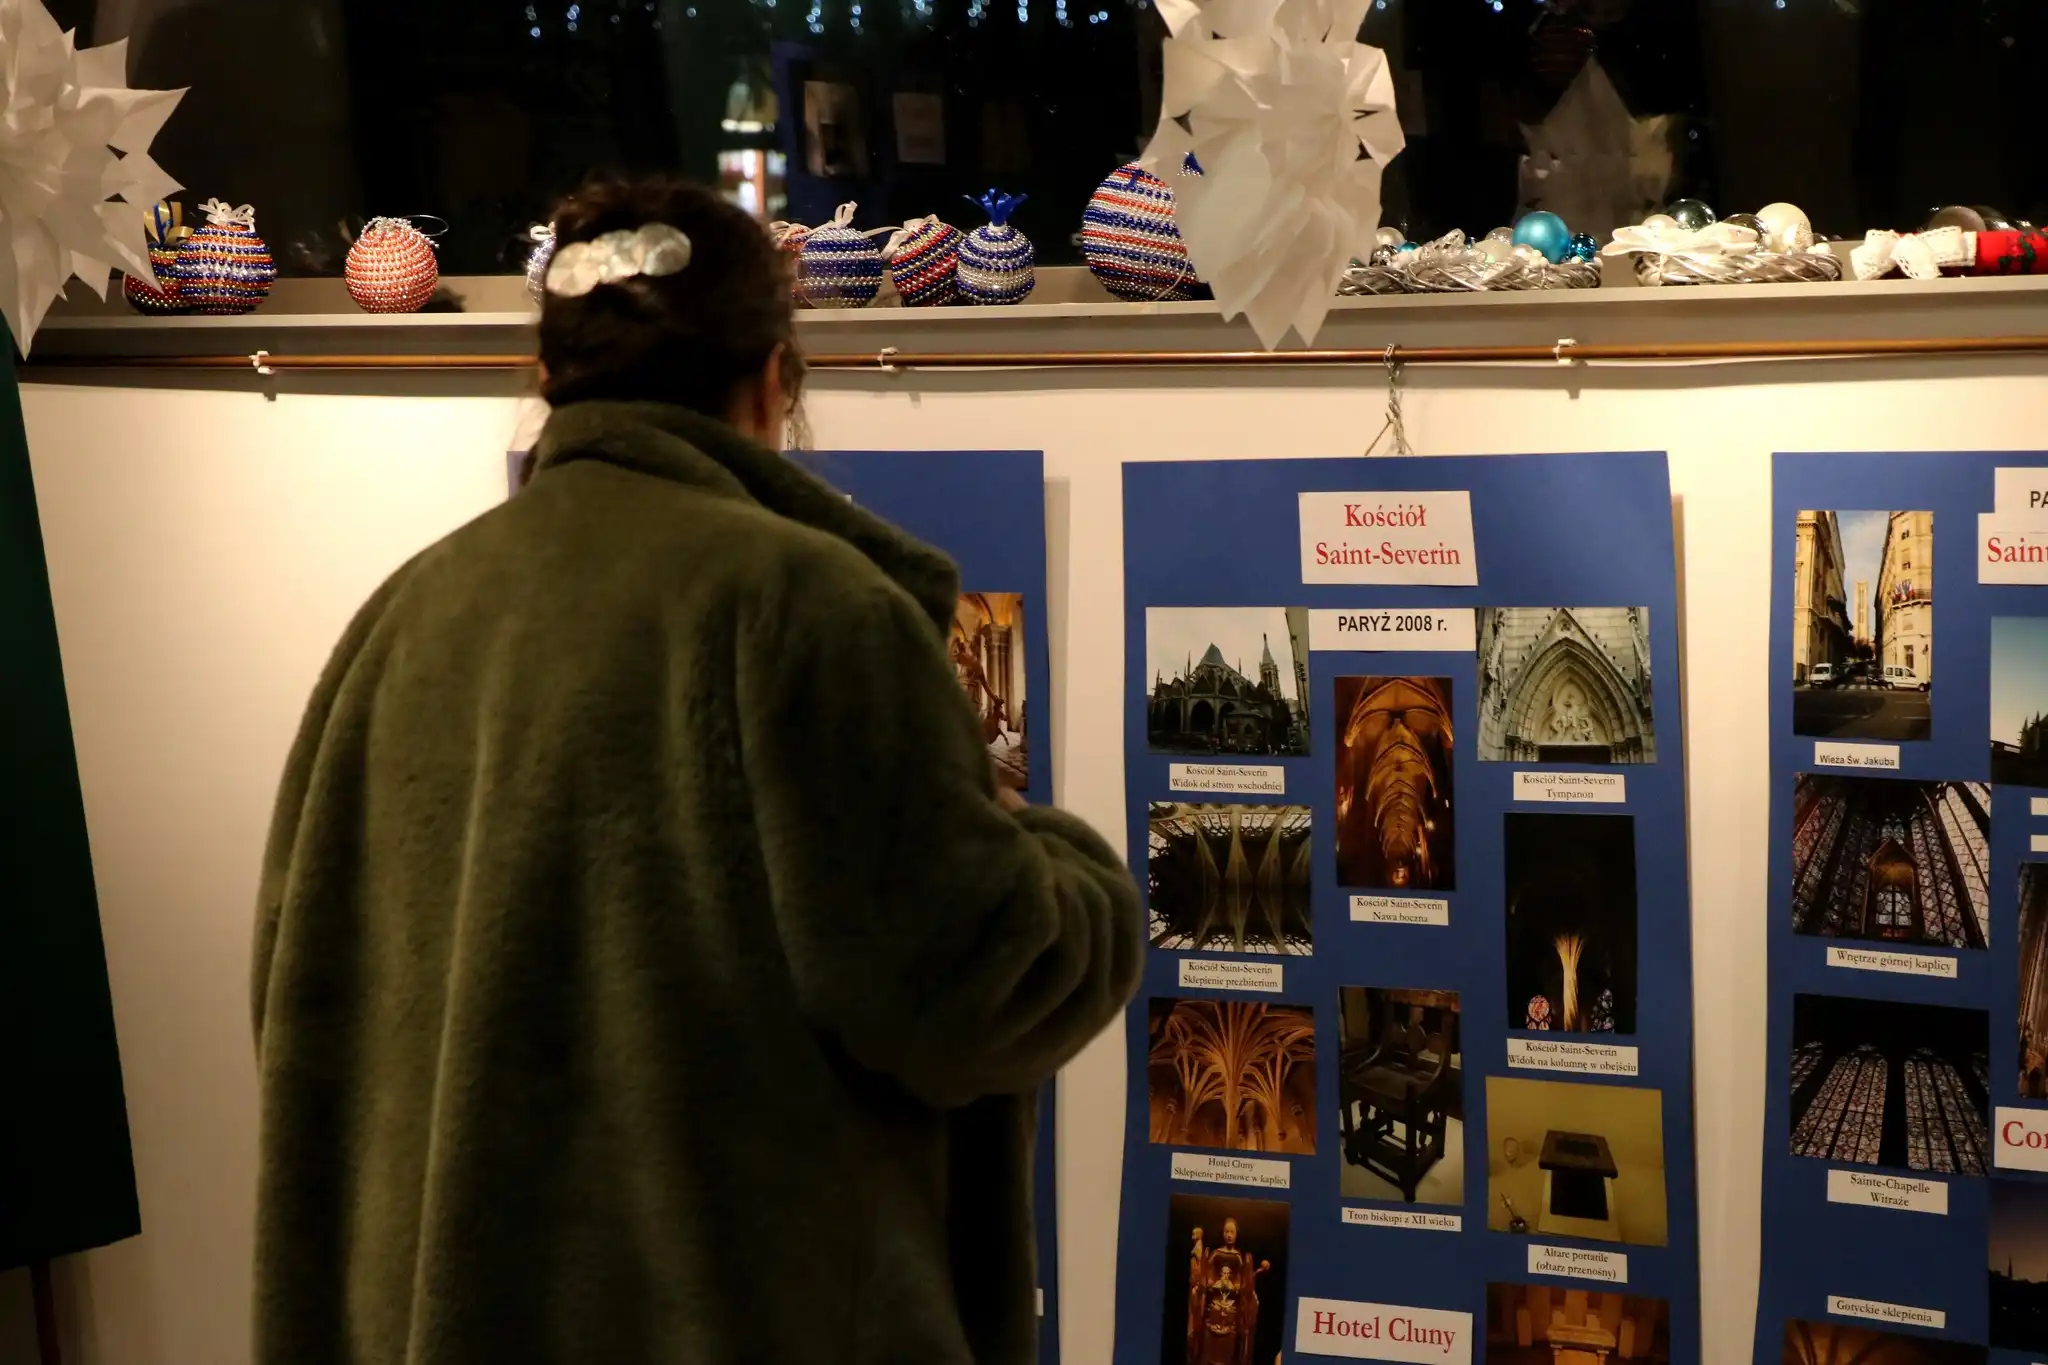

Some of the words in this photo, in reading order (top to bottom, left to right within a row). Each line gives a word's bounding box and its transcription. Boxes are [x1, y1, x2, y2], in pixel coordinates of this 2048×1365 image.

[1344, 504, 1427, 527] Kościół
[1316, 541, 1461, 565] Saint-Severin
[1338, 612, 1391, 631] PARYŻ
[1395, 615, 1432, 631] 2008
[1437, 618, 1447, 631] r.
[1820, 754, 1845, 764] Wieża
[1847, 753, 1862, 765] Św.
[1864, 756, 1895, 766] Jakuba
[1186, 765, 1215, 775] Kościół
[1216, 766, 1268, 777] Saint-Severin
[1172, 778, 1198, 788] Widok
[1200, 779, 1210, 788] od
[1212, 780, 1235, 791] strony
[1237, 780, 1283, 792] wschodniej
[1523, 774, 1556, 784] Kościół
[1559, 774, 1616, 785] Saint-Severin
[1546, 788, 1594, 801] Tympanon
[1356, 897, 1388, 907] Kościół
[1390, 899, 1443, 911] Saint-Severin
[1373, 911, 1398, 921] Nawa
[1399, 912, 1429, 923] boczna
[1188, 961, 1218, 972] Kościół
[1220, 963, 1273, 974] Saint-Severin
[1836, 950, 1878, 965] Wnętrze
[1880, 955, 1913, 969] górnej
[1915, 958, 1953, 974] kaplicy
[1183, 974, 1224, 987] Sklepienie
[1226, 977, 1278, 988] prezbiterium
[1525, 1042, 1558, 1053] Kościół
[1560, 1044, 1618, 1057] Saint-Severin
[1508, 1054, 1536, 1065] Widok
[1538, 1058, 1549, 1067] na
[1550, 1057, 1588, 1071] kolumnę
[1590, 1062, 1598, 1070] w
[1600, 1061, 1637, 1073] obejściu
[1208, 1157, 1230, 1169] Hotel
[1231, 1159, 1255, 1172] Cluny
[1174, 1167, 1214, 1179] Sklepienie
[1215, 1171, 1250, 1182] palmowe
[1260, 1174, 1288, 1186] kaplicy
[1849, 1173, 1931, 1195] Sainte-Chapelle
[1870, 1191, 1910, 1207] Witraże
[1347, 1209, 1369, 1221] Tron
[1370, 1211, 1403, 1226] biskupi
[1411, 1215, 1427, 1225] XII
[1428, 1217, 1455, 1227] wieku
[1543, 1247, 1571, 1259] Altare
[1572, 1252, 1609, 1263] portatile
[1536, 1260, 1566, 1272] (ołtarz
[1567, 1265, 1617, 1280] przenośny)
[1836, 1299, 1881, 1315] Gotyckie
[1882, 1306, 1933, 1322] sklepienia
[1312, 1310, 1381, 1340] Hotel
[1388, 1316, 1457, 1354] Cluny
